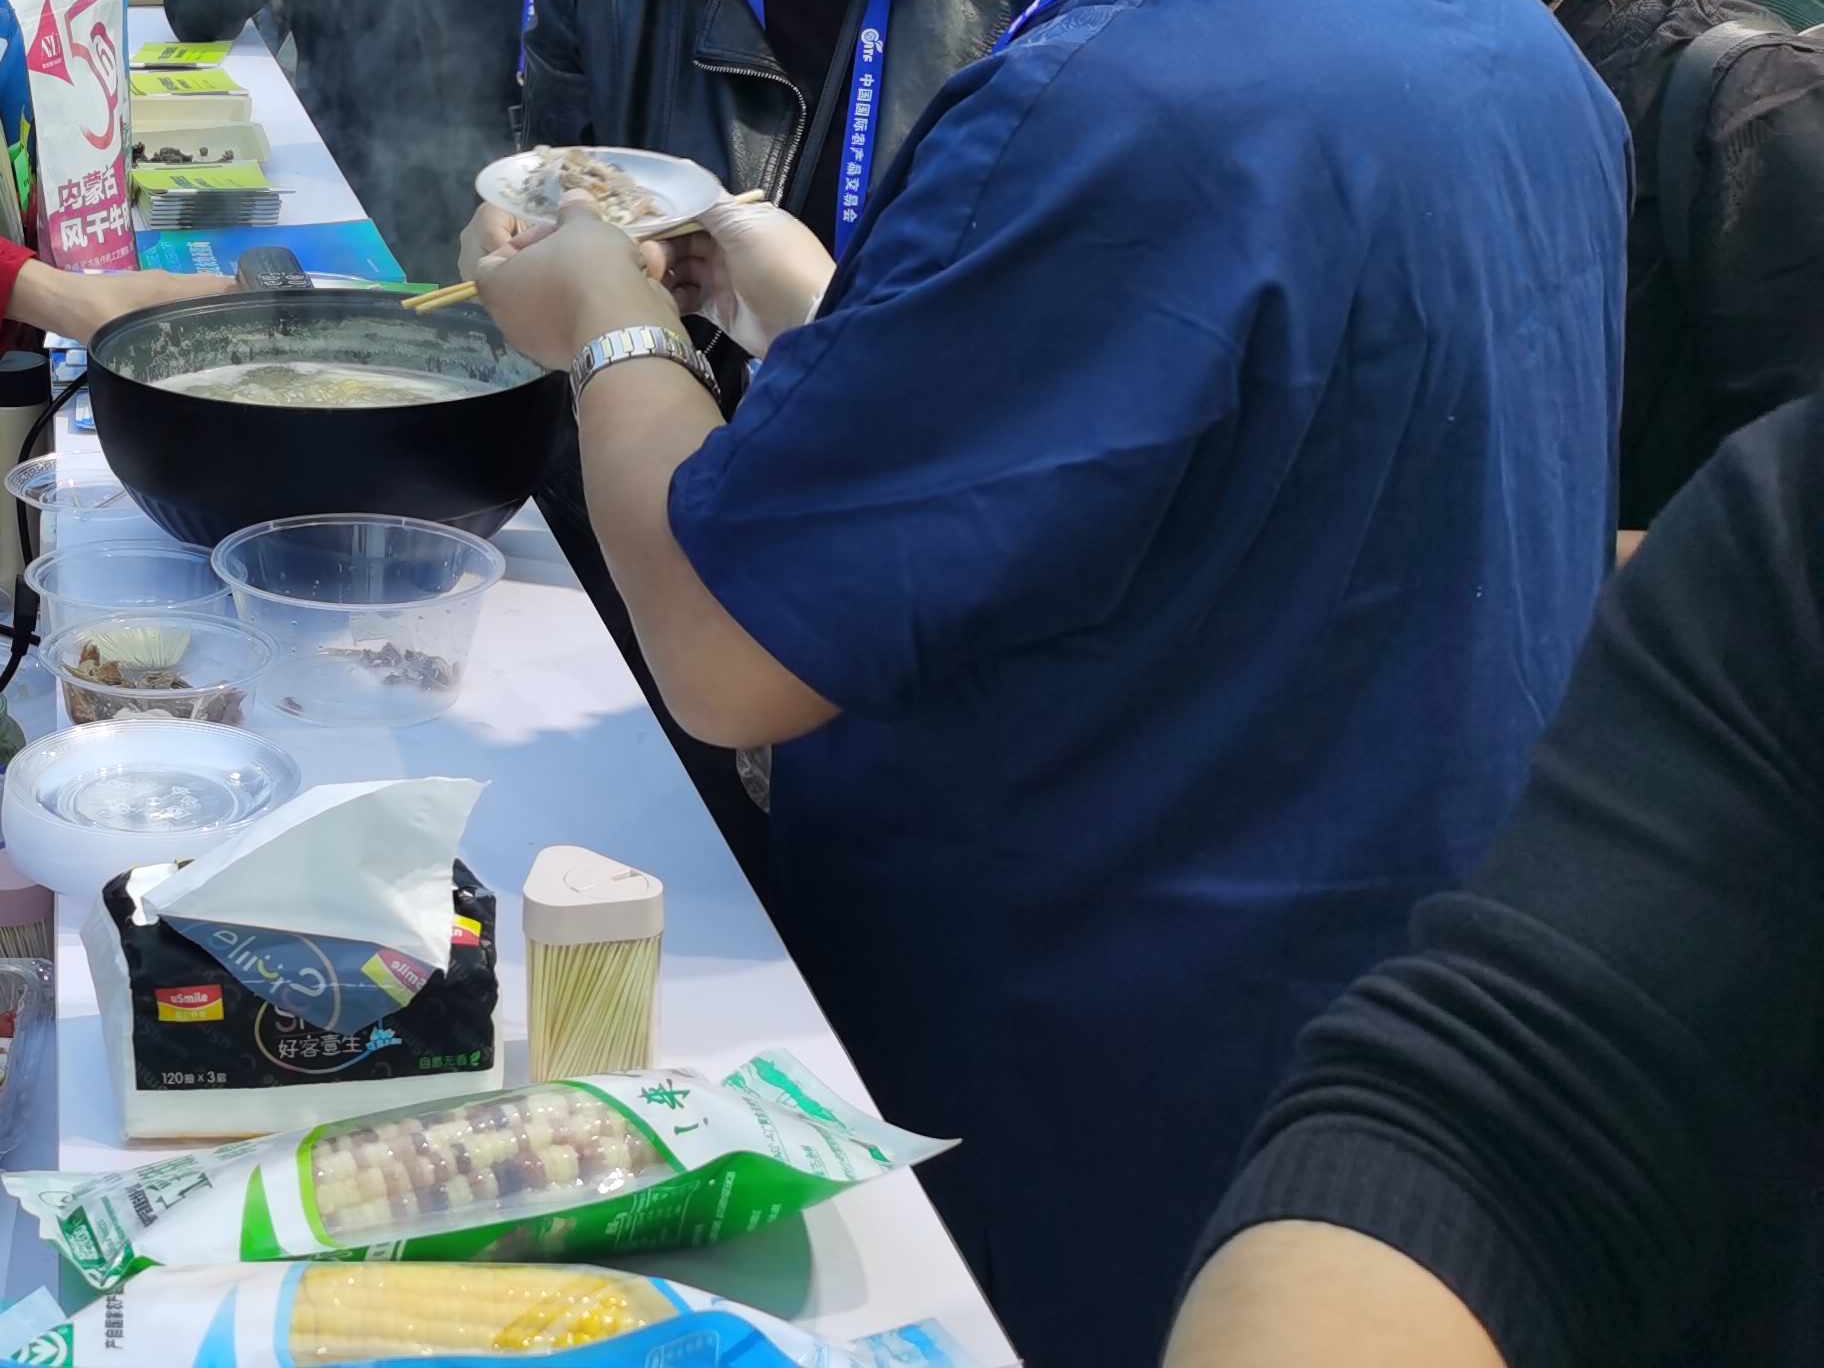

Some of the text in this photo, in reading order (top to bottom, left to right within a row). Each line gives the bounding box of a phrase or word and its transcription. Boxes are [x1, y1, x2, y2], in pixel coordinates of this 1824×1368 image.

[842, 73, 876, 224] 中国国际农产品交易会
[58, 165, 119, 213] 内蒙古
[170, 992, 209, 1004] uSmile
[279, 1035, 363, 1058] 好客壹生
